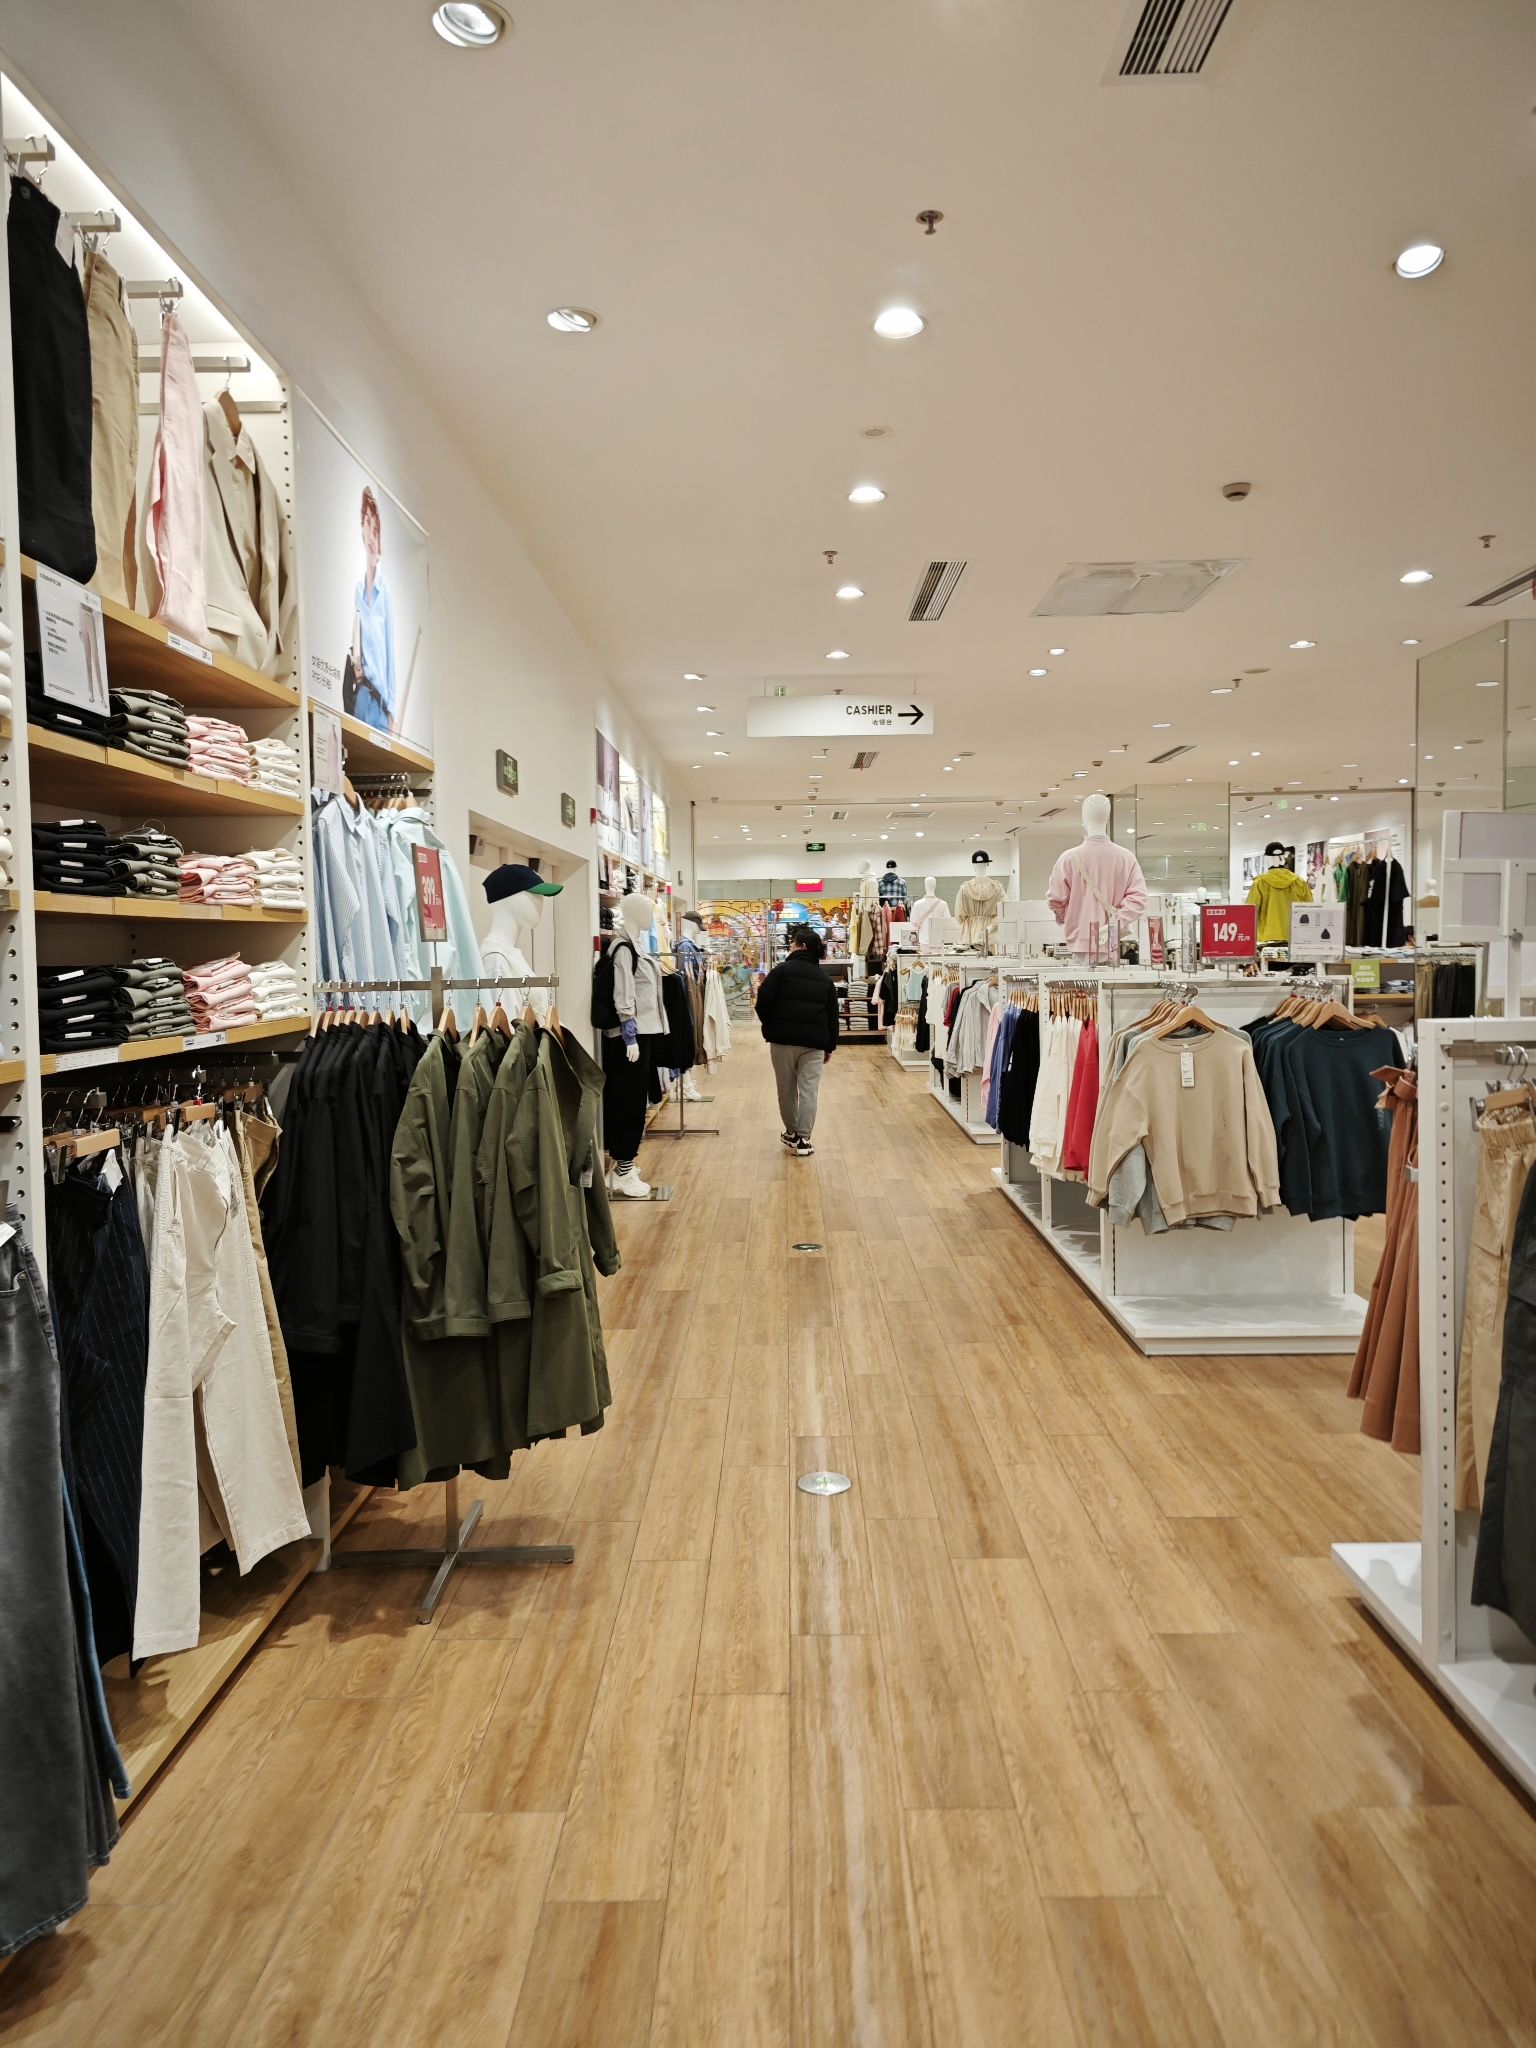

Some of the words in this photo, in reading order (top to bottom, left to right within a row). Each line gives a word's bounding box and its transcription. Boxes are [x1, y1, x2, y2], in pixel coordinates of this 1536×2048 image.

[846, 705, 893, 715] CASHIER
[421, 875, 436, 905] 399
[1213, 922, 1238, 942] 149
